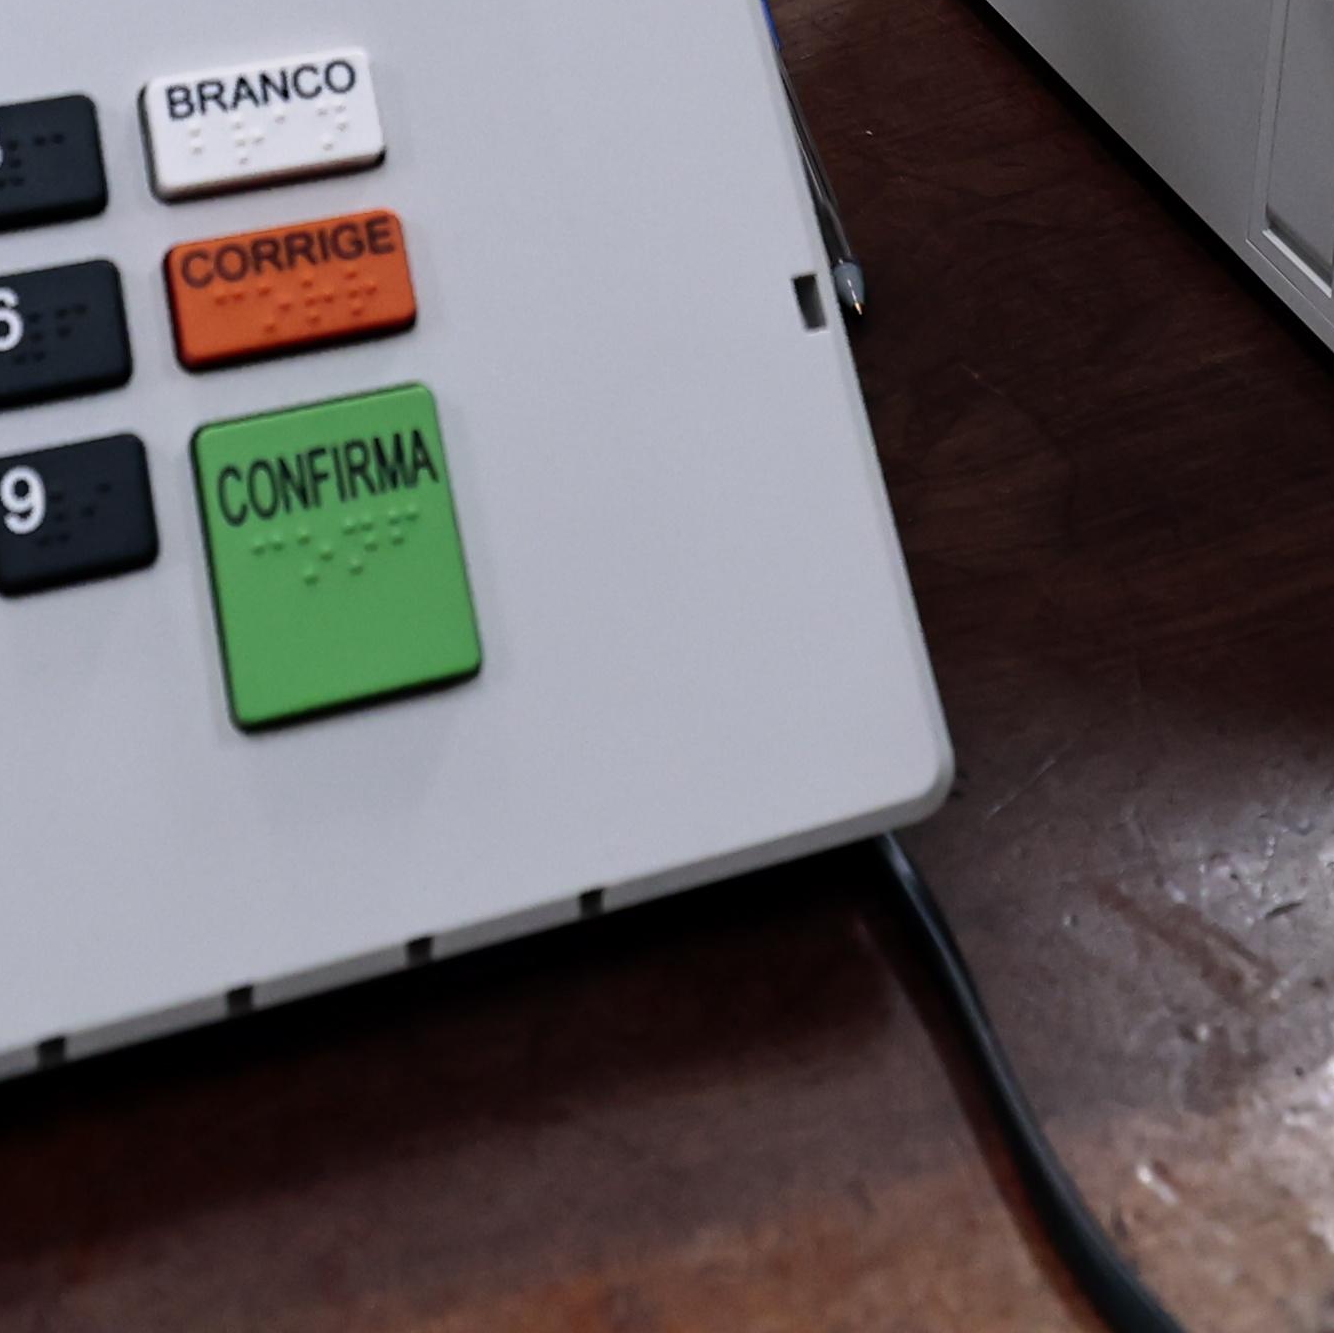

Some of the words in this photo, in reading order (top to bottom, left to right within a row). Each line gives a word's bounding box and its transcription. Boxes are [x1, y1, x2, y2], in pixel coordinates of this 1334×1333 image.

[166, 59, 357, 122] BRANCO
[180, 215, 396, 291] CORRIGE
[0, 466, 47, 535] 9
[217, 427, 440, 531] CONFIRMA
